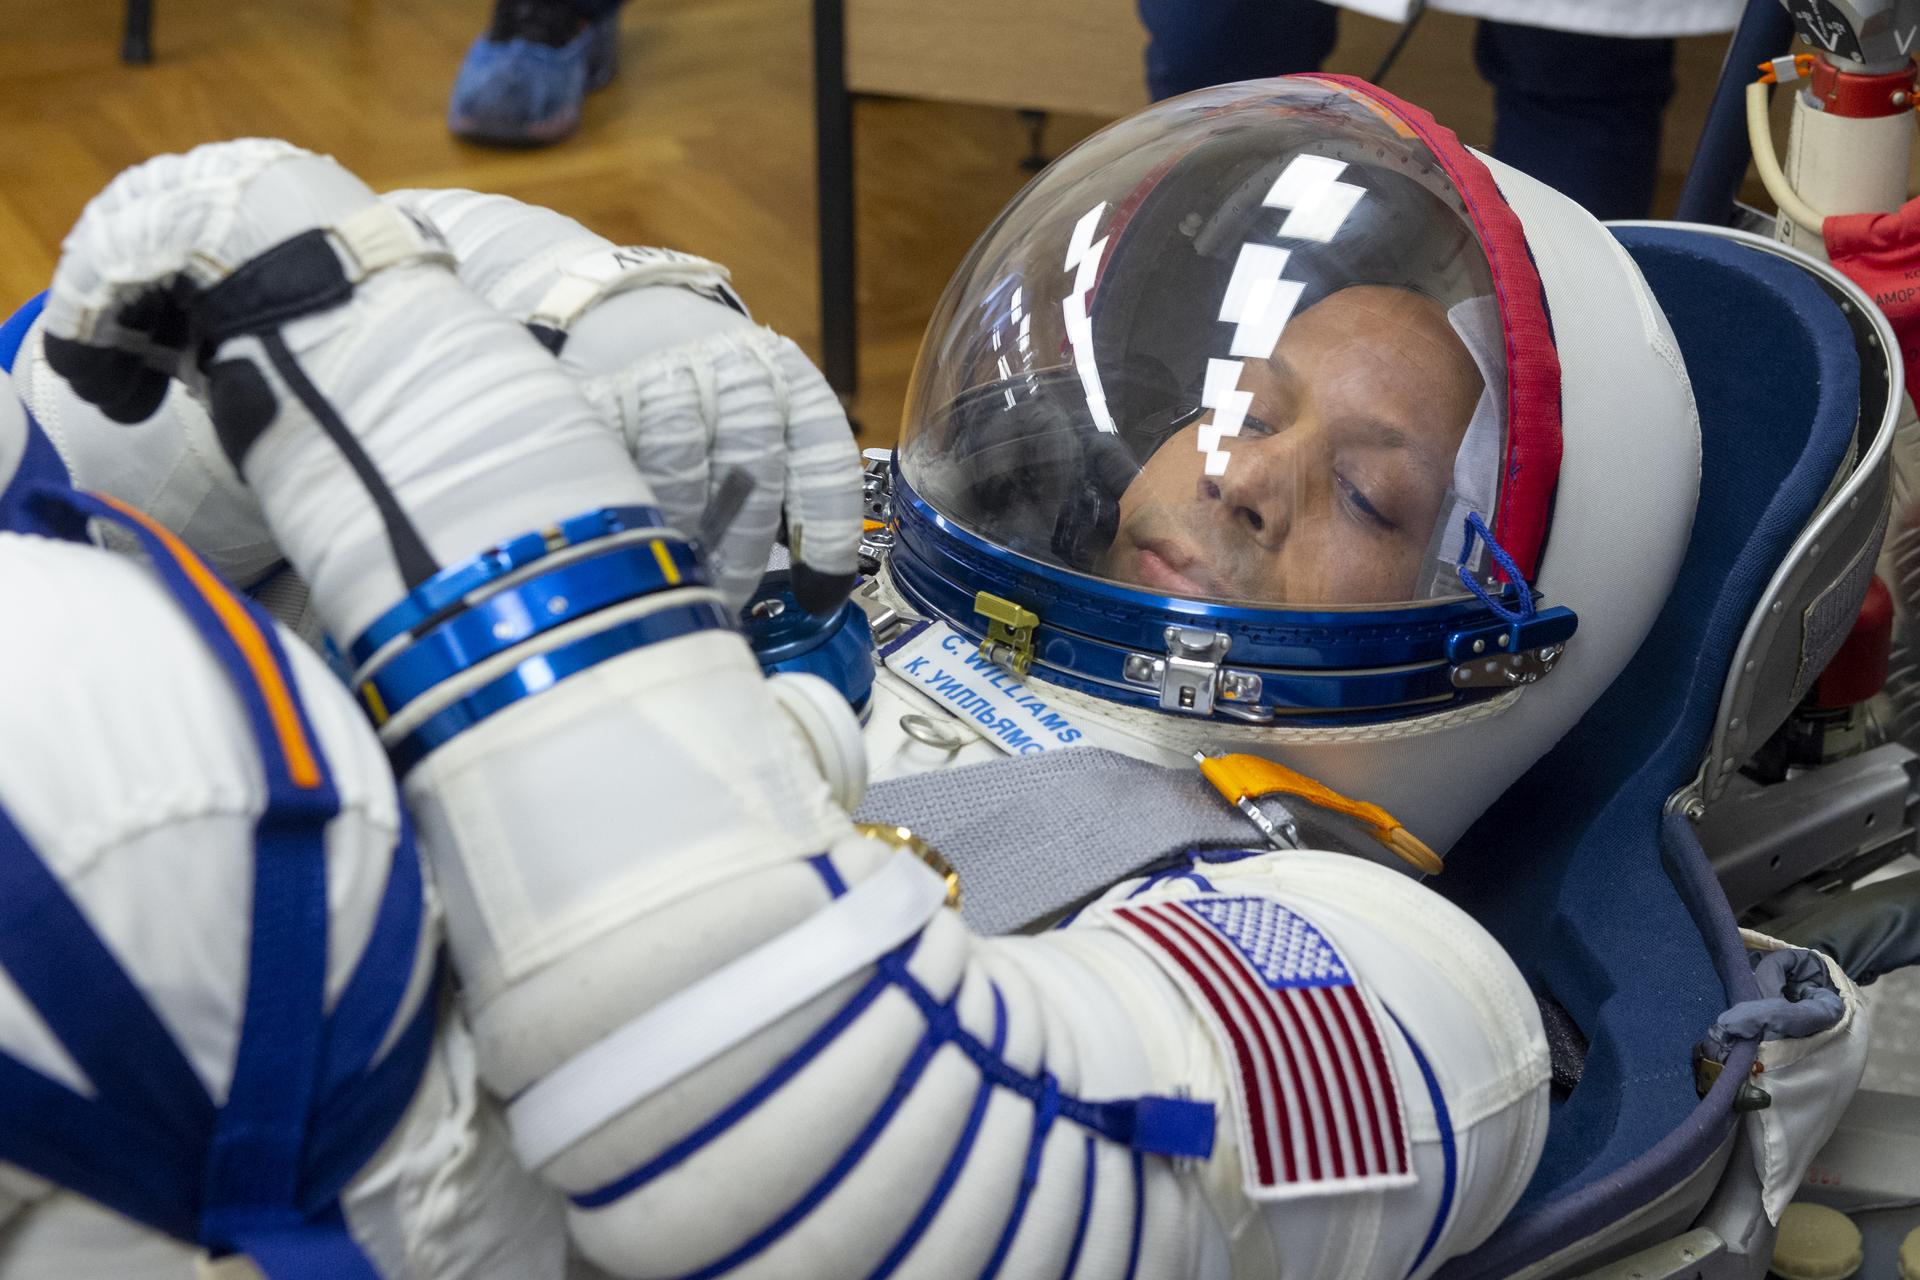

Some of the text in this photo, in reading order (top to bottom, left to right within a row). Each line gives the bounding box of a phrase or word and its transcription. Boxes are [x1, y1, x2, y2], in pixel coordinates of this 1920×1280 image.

[903, 656, 1045, 756] К. УИЛЛЬЯМС
[941, 634, 1082, 744] C. WILLIAMS
